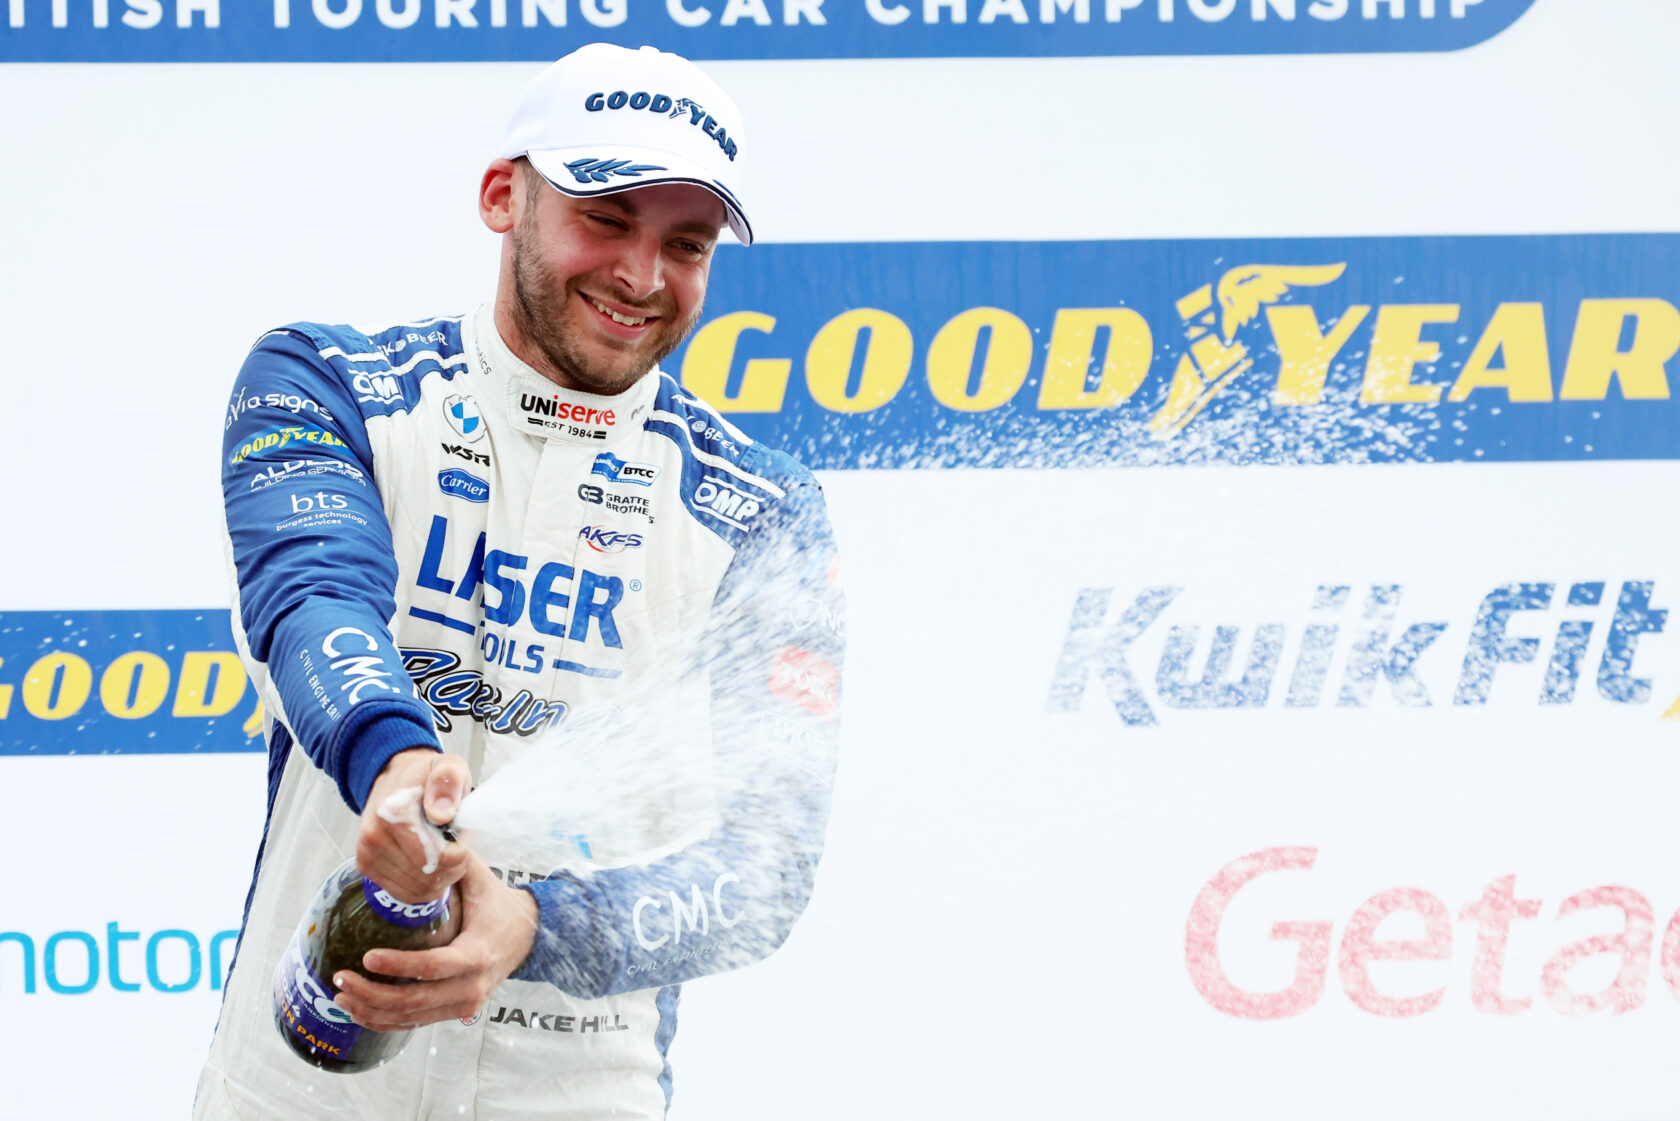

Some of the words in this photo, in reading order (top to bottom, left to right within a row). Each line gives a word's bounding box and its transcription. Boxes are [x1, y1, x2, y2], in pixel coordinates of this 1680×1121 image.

[544, 421, 564, 431] EST
[567, 425, 593, 439] 1984
[441, 443, 491, 467] WSR
[623, 466, 655, 479] BTCC
[441, 474, 488, 497] Carrier
[290, 491, 348, 513] bts
[606, 493, 650, 507] GRATTE
[694, 481, 760, 522] OMP
[276, 515, 313, 532] burgess
[314, 511, 368, 526] technology
[303, 518, 342, 527] services
[605, 505, 655, 525] BROTHES
[579, 526, 644, 548] AKFS
[299, 649, 315, 677] CIVIL
[0, 650, 248, 721] OOD
[373, 889, 438, 918] BTCC
[631, 872, 746, 952] CMC
[1184, 845, 1680, 1023] Geta
[489, 1006, 576, 1033] JAKE
[579, 1012, 630, 1034] HILL
[296, 1024, 341, 1055] PARK
